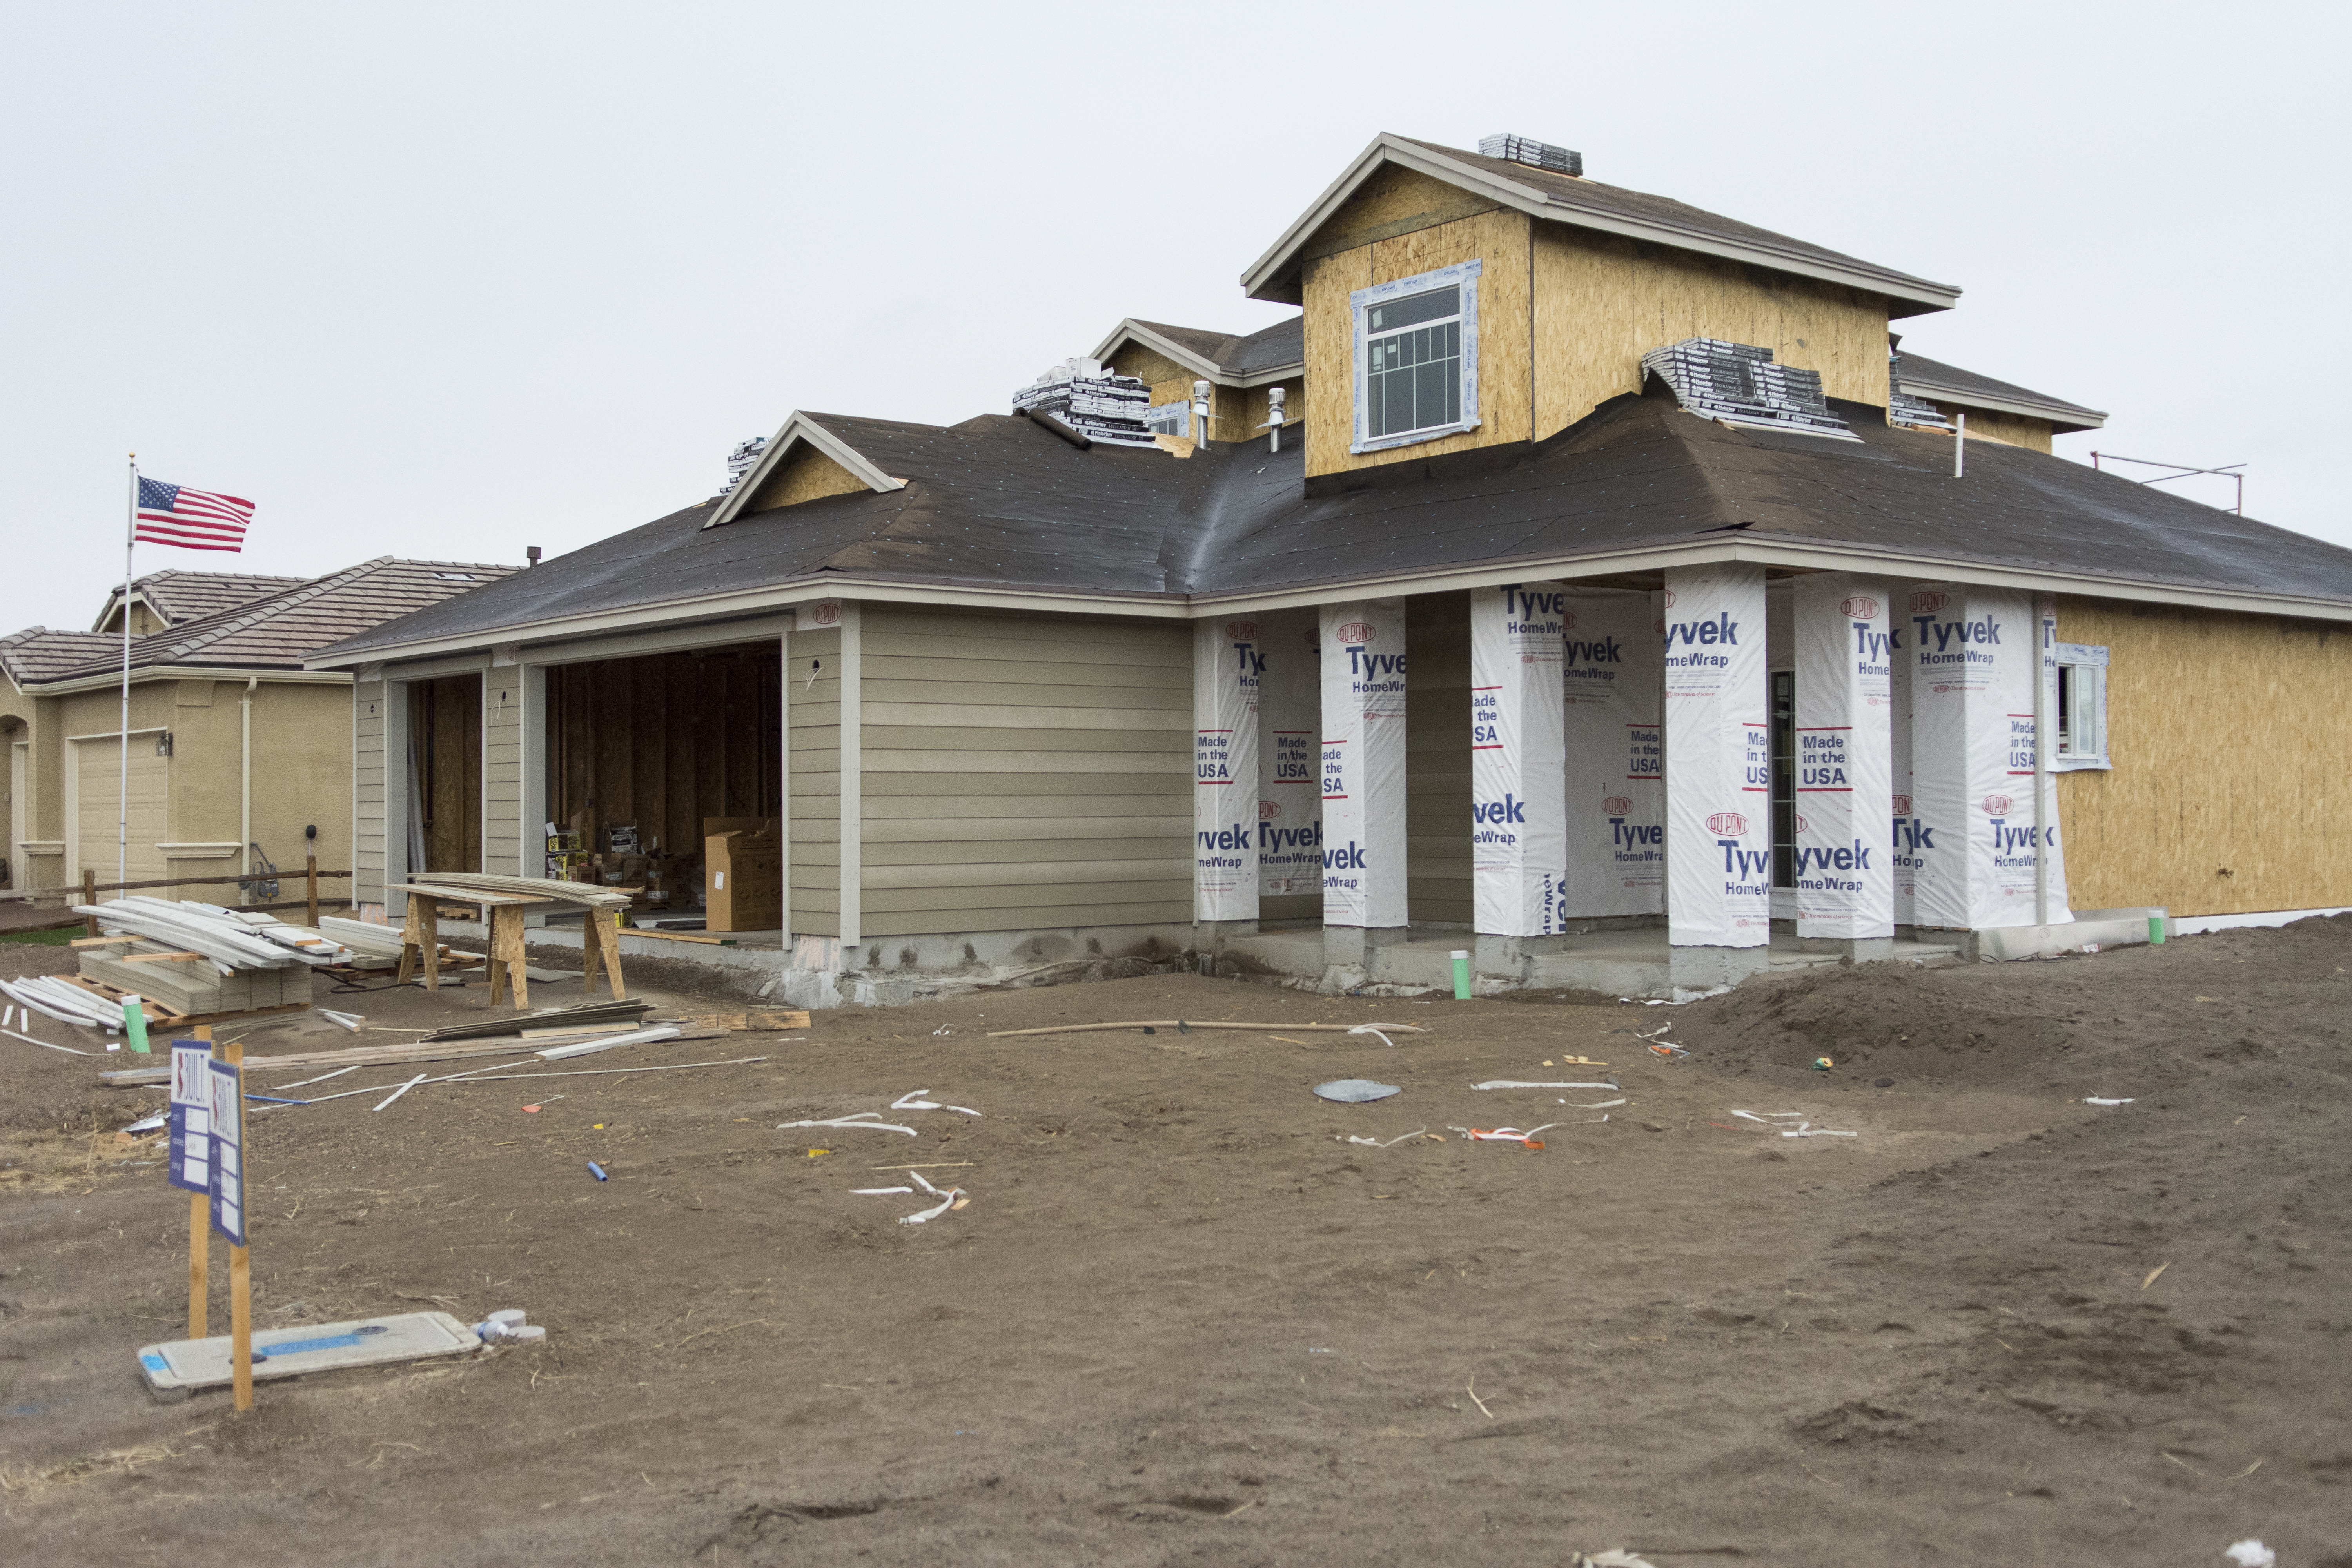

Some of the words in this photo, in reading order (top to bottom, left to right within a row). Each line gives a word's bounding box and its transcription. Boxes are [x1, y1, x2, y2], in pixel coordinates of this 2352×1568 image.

[1913, 614, 2000, 652] Tyvek
[1921, 650, 1994, 666] HomeWrap
[1477, 709, 1497, 721] the
[2012, 721, 2034, 733] Made
[1199, 736, 1227, 747] Made
[1278, 737, 1307, 748] Made
[1631, 731, 1659, 742] Made
[1804, 735, 1844, 748] Made
[2011, 736, 2018, 748] in
[2022, 736, 2035, 748] the
[1198, 750, 1207, 760] in
[1210, 749, 1228, 760] the
[1278, 750, 1287, 760] in
[1290, 750, 1307, 760] the
[1631, 744, 1640, 755] in
[1643, 744, 1659, 755] the
[1748, 748, 1757, 761] in
[1804, 751, 1817, 763] in
[1821, 751, 1845, 763] the
[2010, 752, 2035, 767] USA
[1198, 764, 1229, 778] USA
[1278, 764, 1308, 777] USA
[1326, 762, 1342, 774] the
[1631, 758, 1659, 773] USA
[1804, 768, 1847, 785] USA
[1259, 821, 1323, 853] Tyvek
[1260, 853, 1321, 864] HomeWrap
